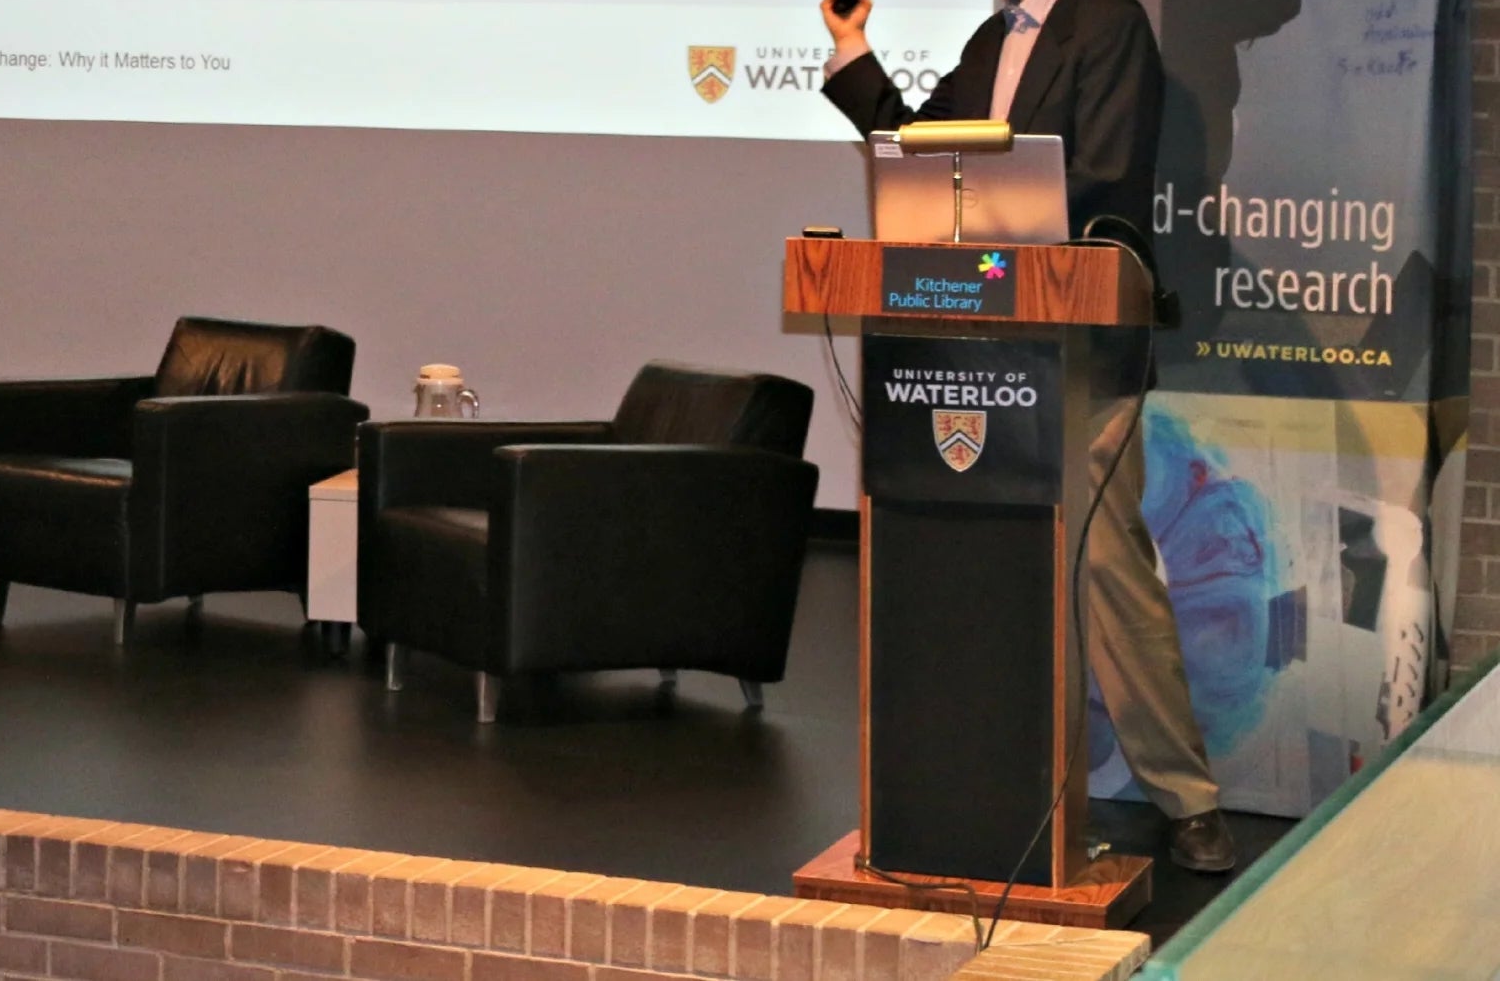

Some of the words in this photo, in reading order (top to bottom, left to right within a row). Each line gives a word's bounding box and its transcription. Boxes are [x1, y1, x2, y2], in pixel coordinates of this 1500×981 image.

[59, 51, 94, 72] Why
[100, 51, 109, 69] it
[115, 52, 175, 70] Matters
[180, 54, 195, 70] to
[200, 54, 230, 71] You
[757, 47, 890, 61] UNIVERY
[904, 50, 931, 62] OF
[744, 65, 941, 93] WATOO
[1152, 183, 1395, 251] d-changing
[915, 277, 982, 294] Kitchener
[1215, 262, 1393, 315] research
[889, 293, 930, 308] Public
[934, 294, 982, 311] Library
[1217, 343, 1391, 366] UWATERLOO.CA
[894, 368, 996, 382] UNIVERSITY
[1005, 372, 1027, 382] OF
[885, 382, 1037, 407] WATERLOO
